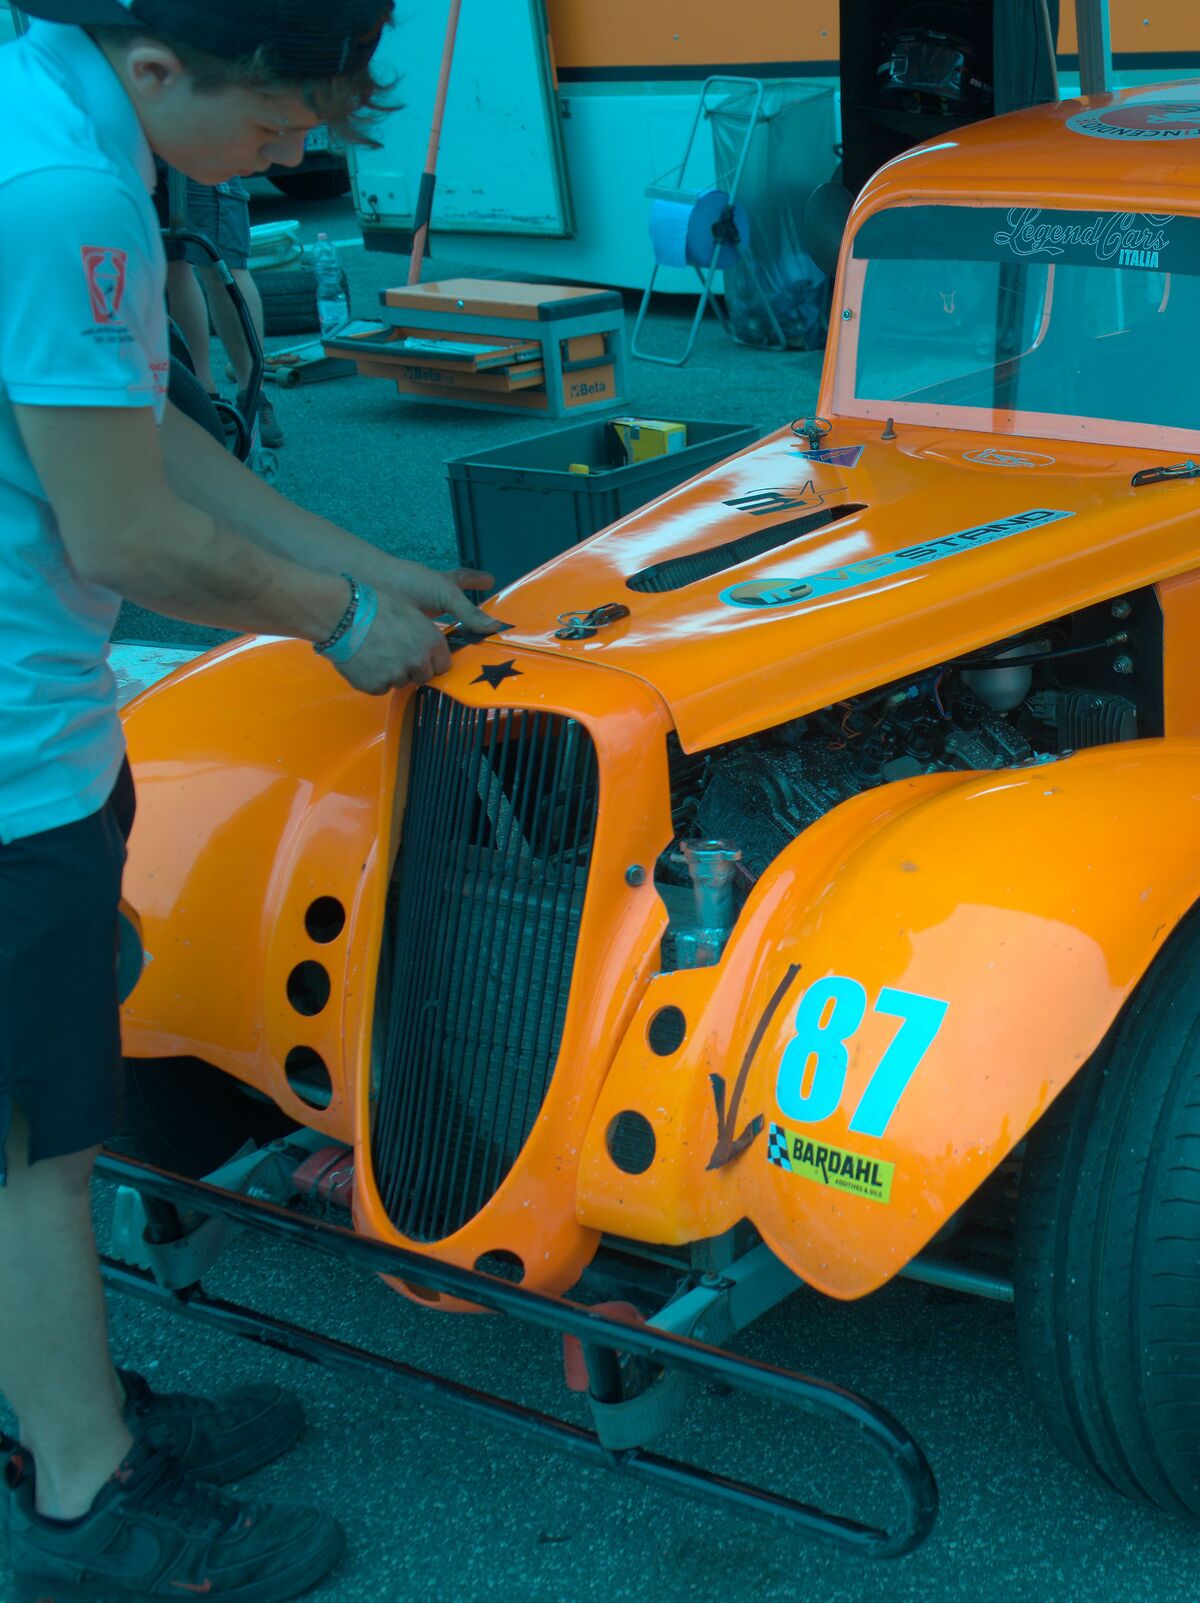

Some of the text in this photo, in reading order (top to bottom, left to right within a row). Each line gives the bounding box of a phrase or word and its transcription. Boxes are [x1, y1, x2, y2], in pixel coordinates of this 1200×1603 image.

[994, 208, 1170, 260] Legend Cars
[1119, 249, 1159, 268] ITALIA
[580, 382, 605, 396] Beta
[814, 557, 896, 580] VIP
[895, 511, 1055, 559] STAND
[775, 975, 950, 1138] 87
[793, 1138, 883, 1187] BARDAHL
[835, 1178, 863, 1192] ADDITIVES
